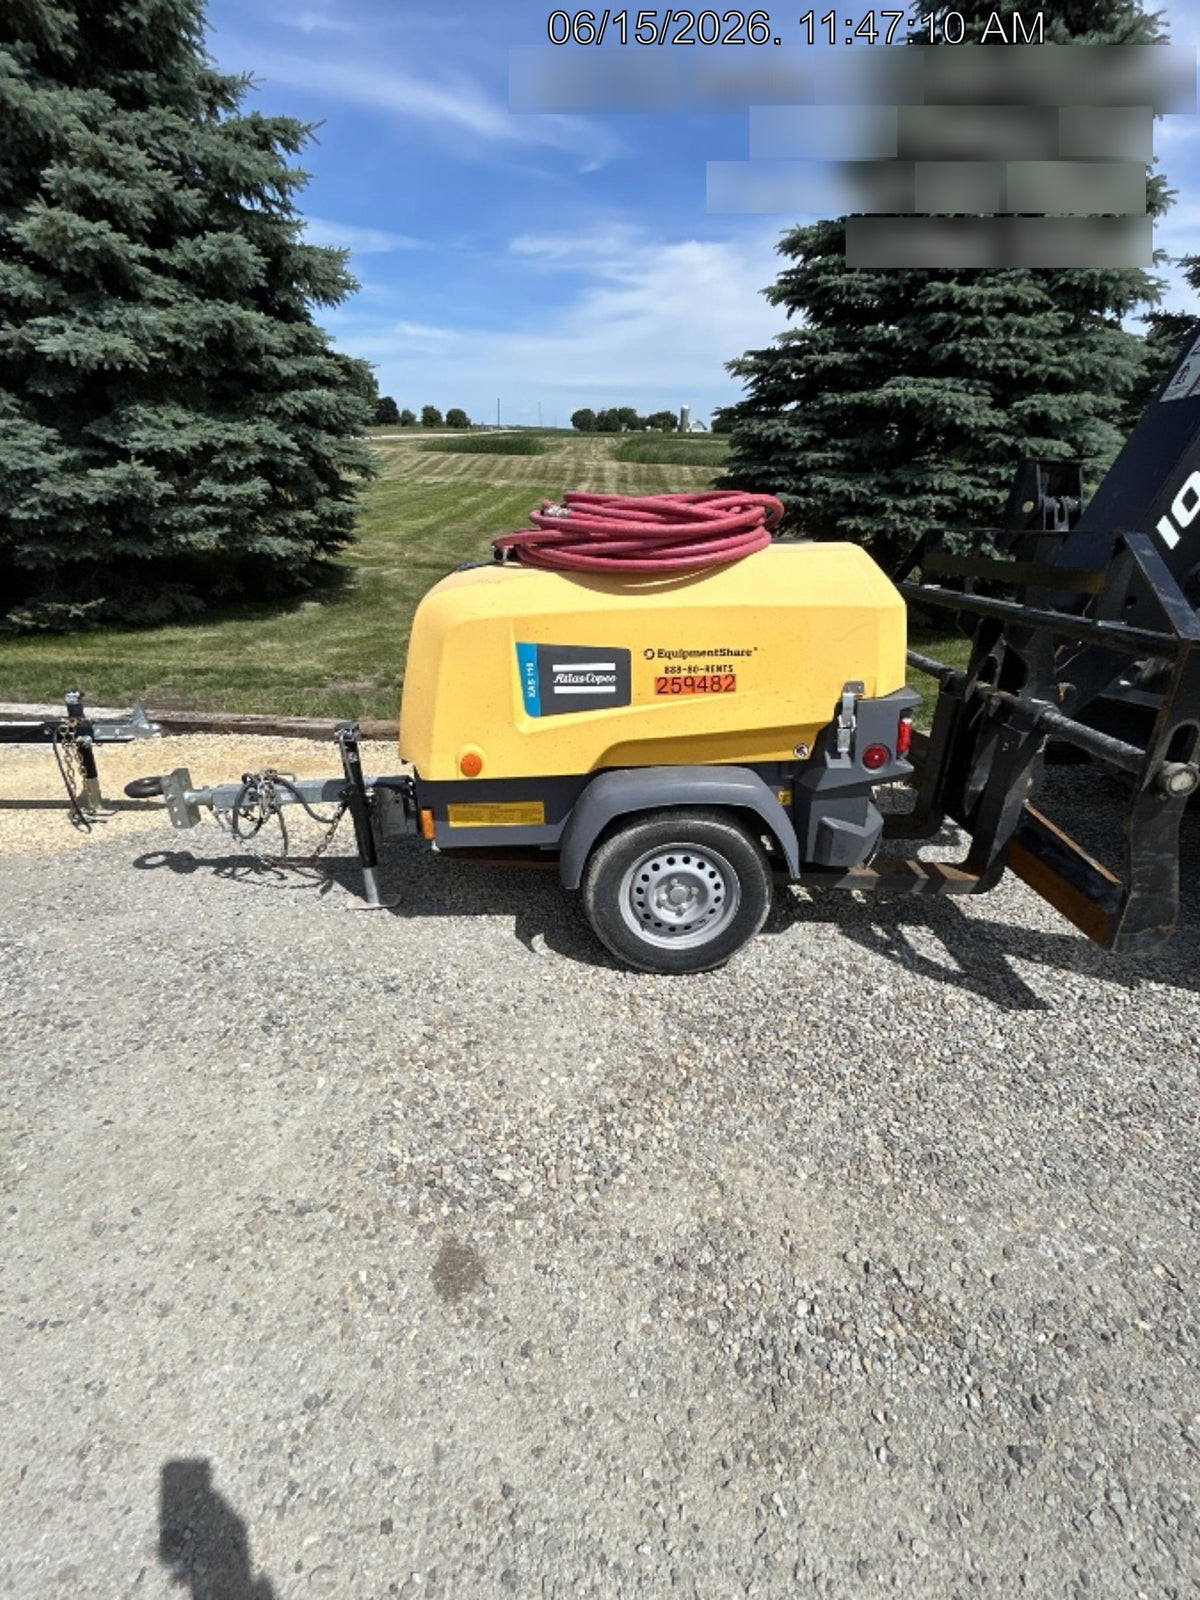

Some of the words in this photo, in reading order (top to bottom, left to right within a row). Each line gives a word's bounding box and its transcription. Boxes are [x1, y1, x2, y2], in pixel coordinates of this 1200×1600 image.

[657, 648, 752, 659] EquipmentShare
[553, 673, 584, 684] Atlas
[586, 672, 616, 685] Copco
[657, 674, 736, 694] 259482
